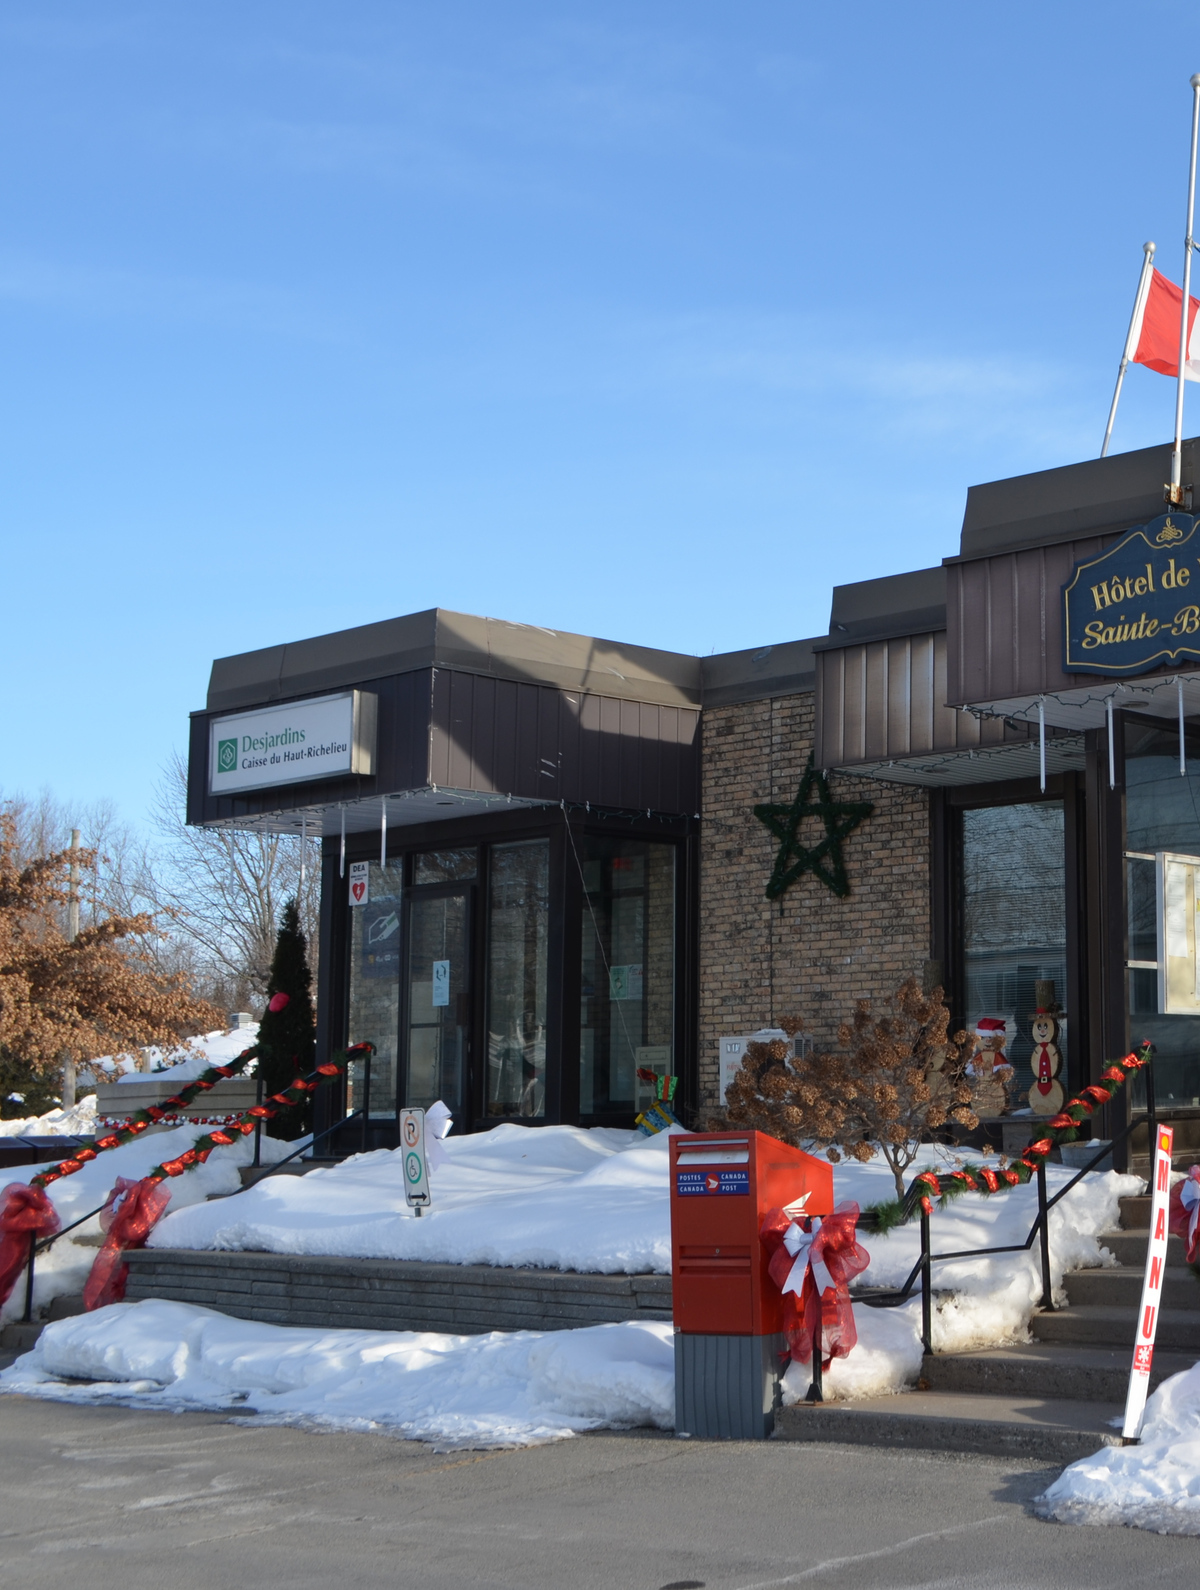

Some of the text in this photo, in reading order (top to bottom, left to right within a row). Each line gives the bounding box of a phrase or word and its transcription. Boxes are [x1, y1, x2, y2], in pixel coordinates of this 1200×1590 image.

[1090, 563, 1156, 612] Hôtel
[1161, 558, 1190, 589] de
[242, 727, 306, 754] Desjardins
[241, 741, 347, 769] Caisse du Haut-Richelieu
[353, 864, 366, 872] DEA
[1142, 1159, 1169, 1339] MANU
